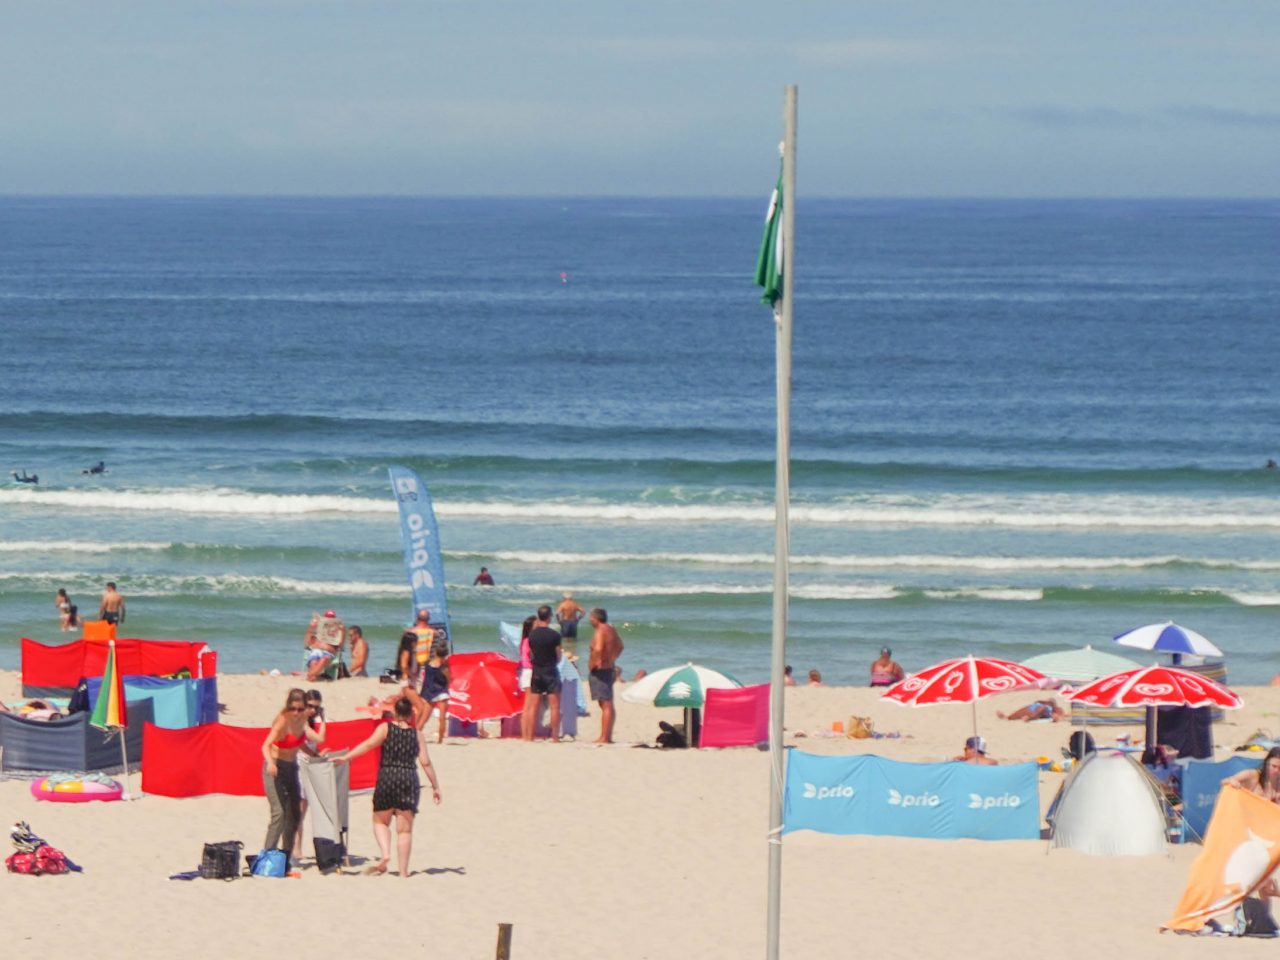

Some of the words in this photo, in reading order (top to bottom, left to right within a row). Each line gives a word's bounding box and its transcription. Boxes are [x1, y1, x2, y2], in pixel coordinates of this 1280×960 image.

[817, 784, 854, 800] prio
[902, 792, 940, 807] prio
[982, 793, 1021, 809] prio
